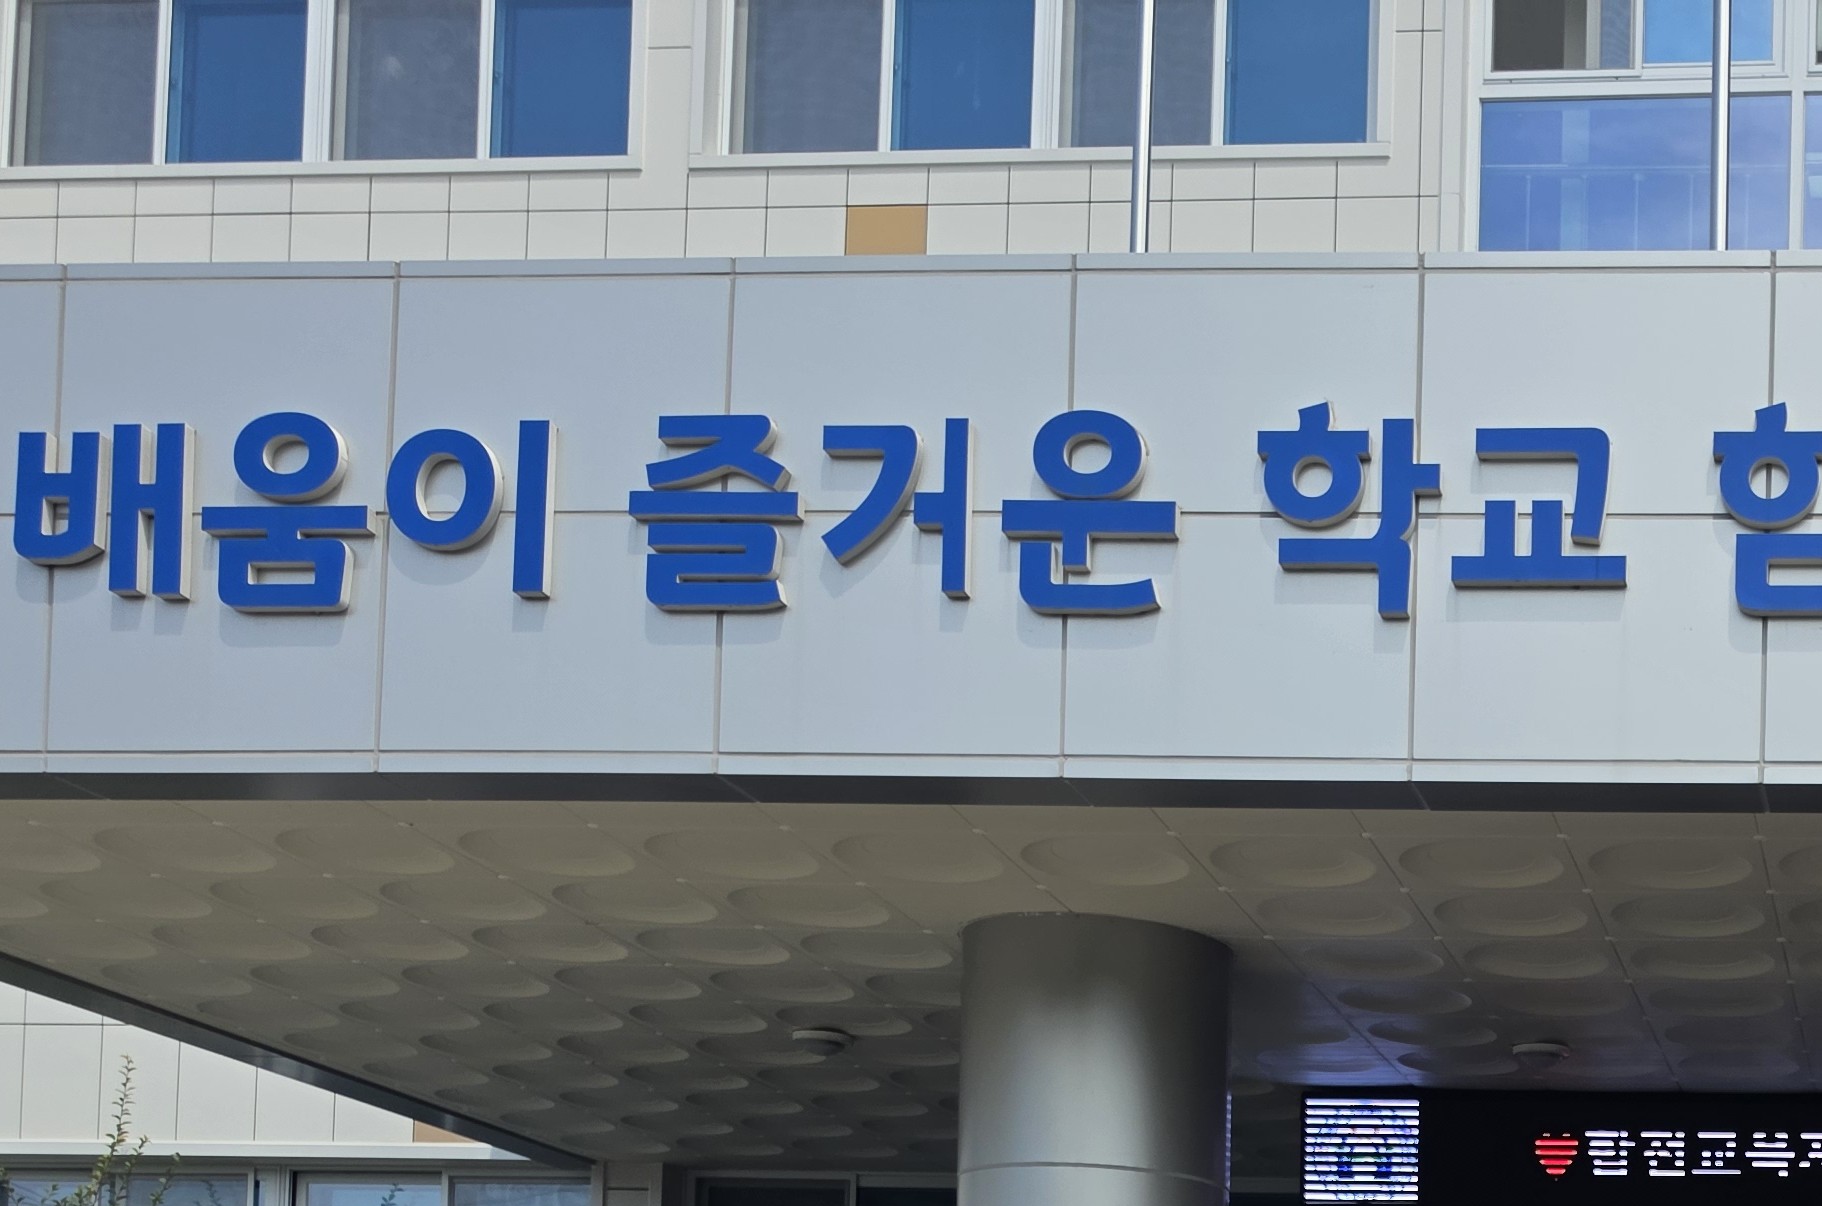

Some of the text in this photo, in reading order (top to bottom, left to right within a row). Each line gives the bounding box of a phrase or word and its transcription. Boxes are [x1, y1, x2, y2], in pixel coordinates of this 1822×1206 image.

[13, 411, 556, 611] 배움이
[629, 410, 1178, 612] 즐거운
[1257, 402, 1630, 616] 학교
